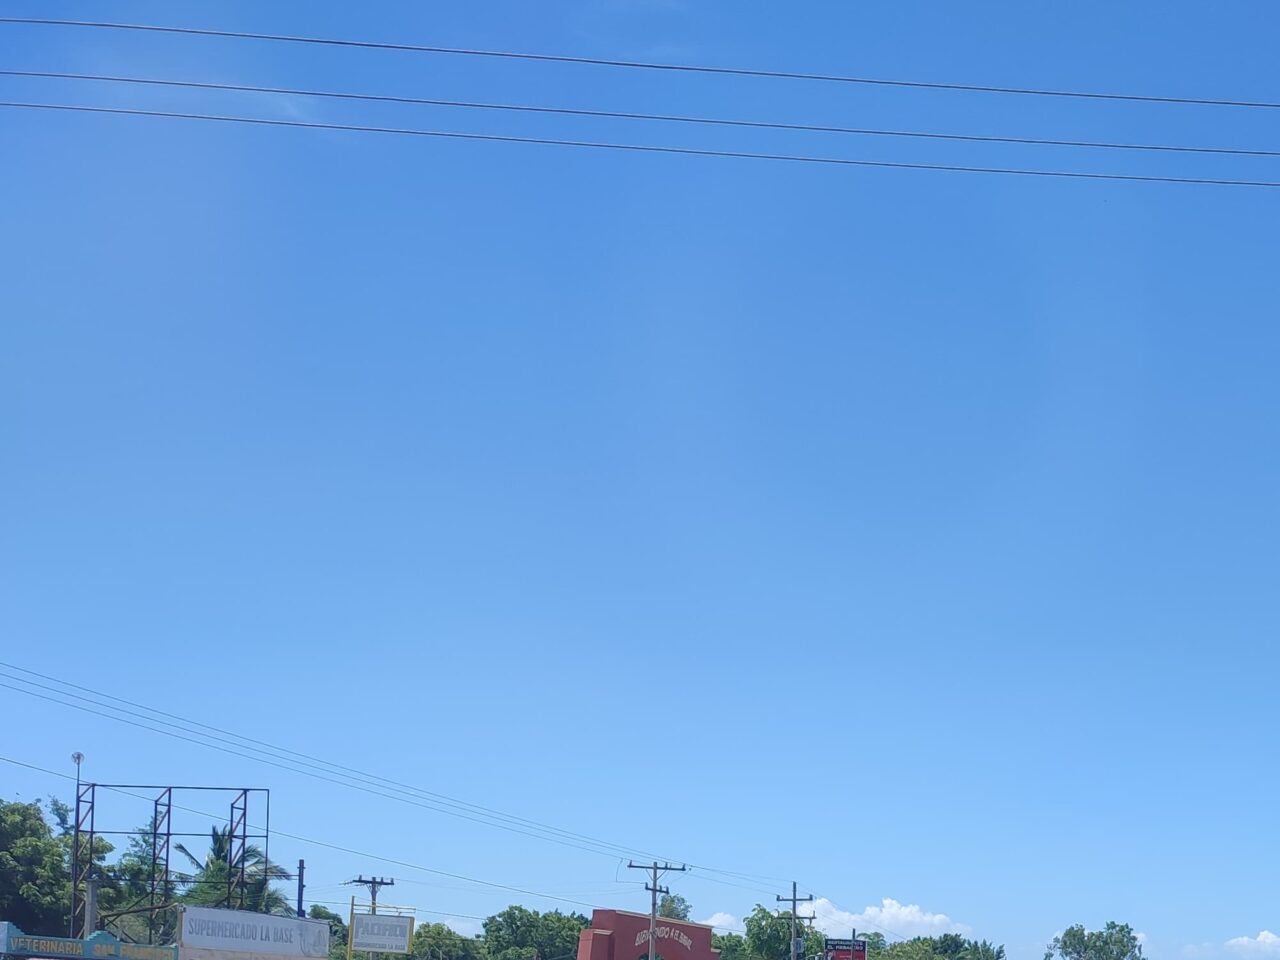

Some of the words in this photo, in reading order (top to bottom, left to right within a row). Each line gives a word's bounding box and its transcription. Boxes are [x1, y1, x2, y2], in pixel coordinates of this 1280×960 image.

[188, 918, 257, 941] SUPERMERCADO
[260, 924, 271, 942] LA
[273, 927, 294, 944] BASE
[10, 937, 84, 956] VETERINARIA
